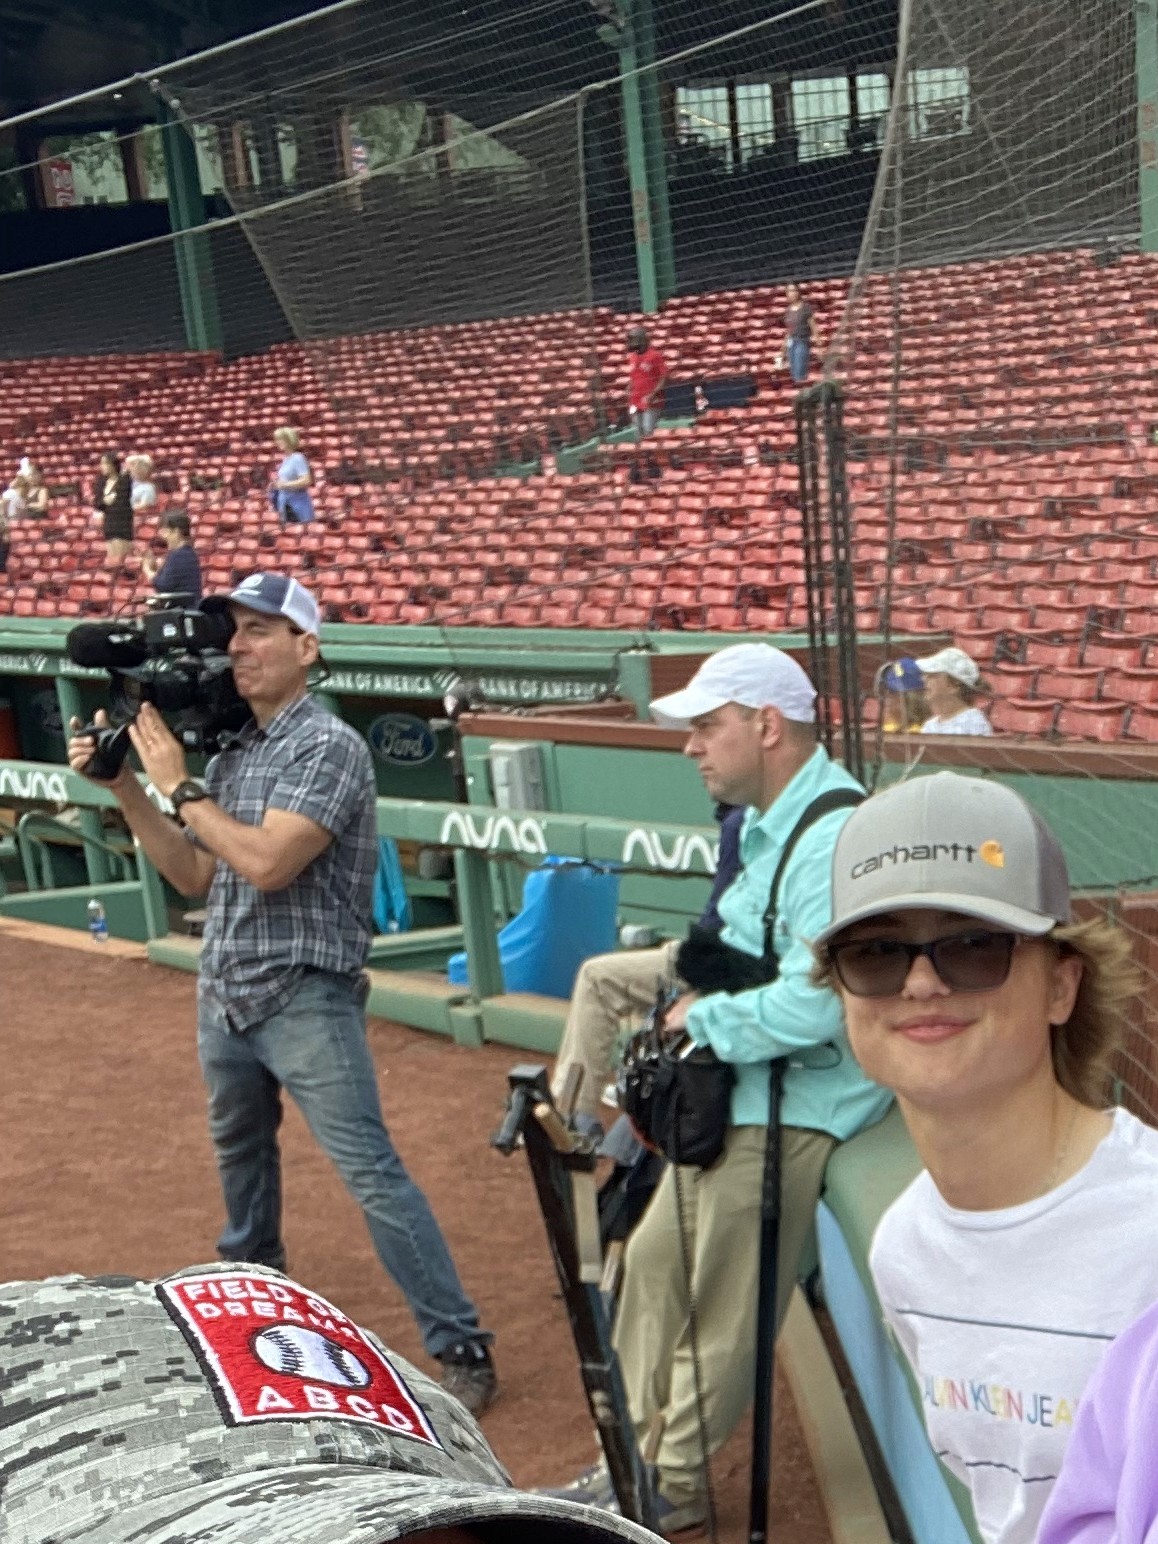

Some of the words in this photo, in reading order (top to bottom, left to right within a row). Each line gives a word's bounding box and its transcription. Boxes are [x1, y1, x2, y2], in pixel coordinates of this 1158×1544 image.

[374, 674, 433, 694] AMERICA
[380, 722, 424, 757] Ford
[622, 829, 718, 874] nun
[851, 842, 977, 880] carhartt
[184, 1280, 293, 1303] FIELD
[257, 1385, 414, 1431] ABCD
